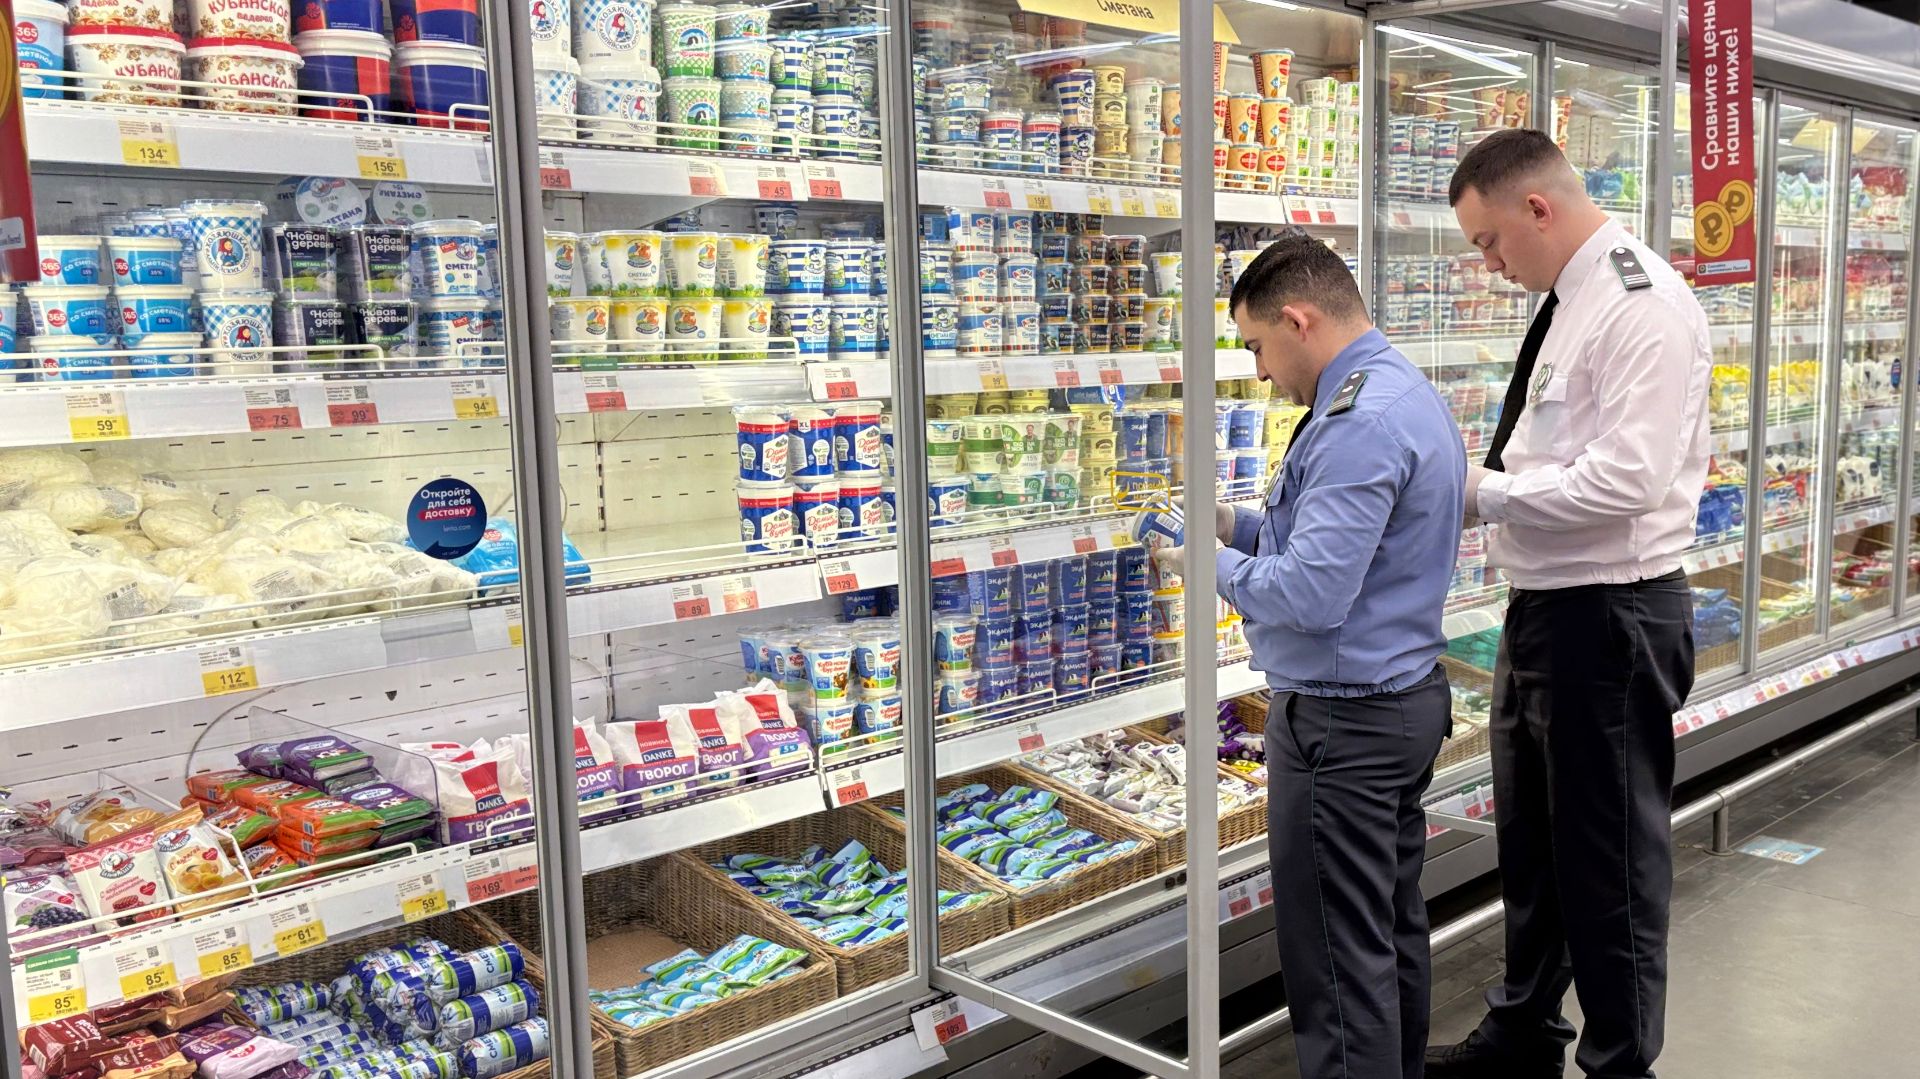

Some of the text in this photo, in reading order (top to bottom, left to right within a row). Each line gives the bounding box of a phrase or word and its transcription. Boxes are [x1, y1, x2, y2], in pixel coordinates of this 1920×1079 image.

[208, 0, 289, 21] КУБАНСКОЕ
[599, 5, 639, 24] ХОЗЯЮШКА
[1096, 0, 1155, 19] Сметана
[16, 27, 38, 37] 365
[1701, 0, 1724, 171] Сравните цены
[1720, 27, 1740, 165] наши ниже!
[139, 147, 163, 160] 134
[373, 160, 393, 173] 156
[544, 175, 561, 185] 154
[774, 187, 785, 196] 45
[286, 231, 326, 242] Новая
[365, 235, 402, 245] Новая
[291, 240, 335, 251] деревня
[369, 243, 410, 253] деревня
[41, 262, 61, 271] 365
[115, 262, 129, 271] 365
[47, 313, 66, 322] 365
[310, 309, 342, 319] Новая
[359, 307, 397, 317] Новая
[363, 314, 408, 324] деревня
[473, 402, 486, 413] 94
[273, 414, 289, 426] 75
[351, 409, 366, 420] 99
[97, 419, 113, 431] 59
[421, 487, 471, 500] Откройте
[427, 496, 472, 510] для себя
[425, 507, 472, 520] доставку
[837, 581, 850, 589] 129
[691, 604, 702, 613] 89
[219, 671, 242, 685] 112
[701, 738, 725, 748] ANKE
[762, 731, 800, 743] ТВОРОГ
[640, 739, 669, 748] НОВИНКА
[644, 750, 673, 762] DANKE
[701, 751, 739, 765] ВОРОГ
[637, 764, 689, 781] ТВОРОГ
[847, 790, 861, 799] 104
[478, 798, 504, 812] DANKE
[481, 881, 501, 894] 169
[422, 898, 435, 909] 59
[297, 928, 312, 941] 61
[222, 952, 239, 966] 85
[145, 973, 162, 986] 85
[54, 996, 71, 1009] 85
[946, 1025, 959, 1035] 109
